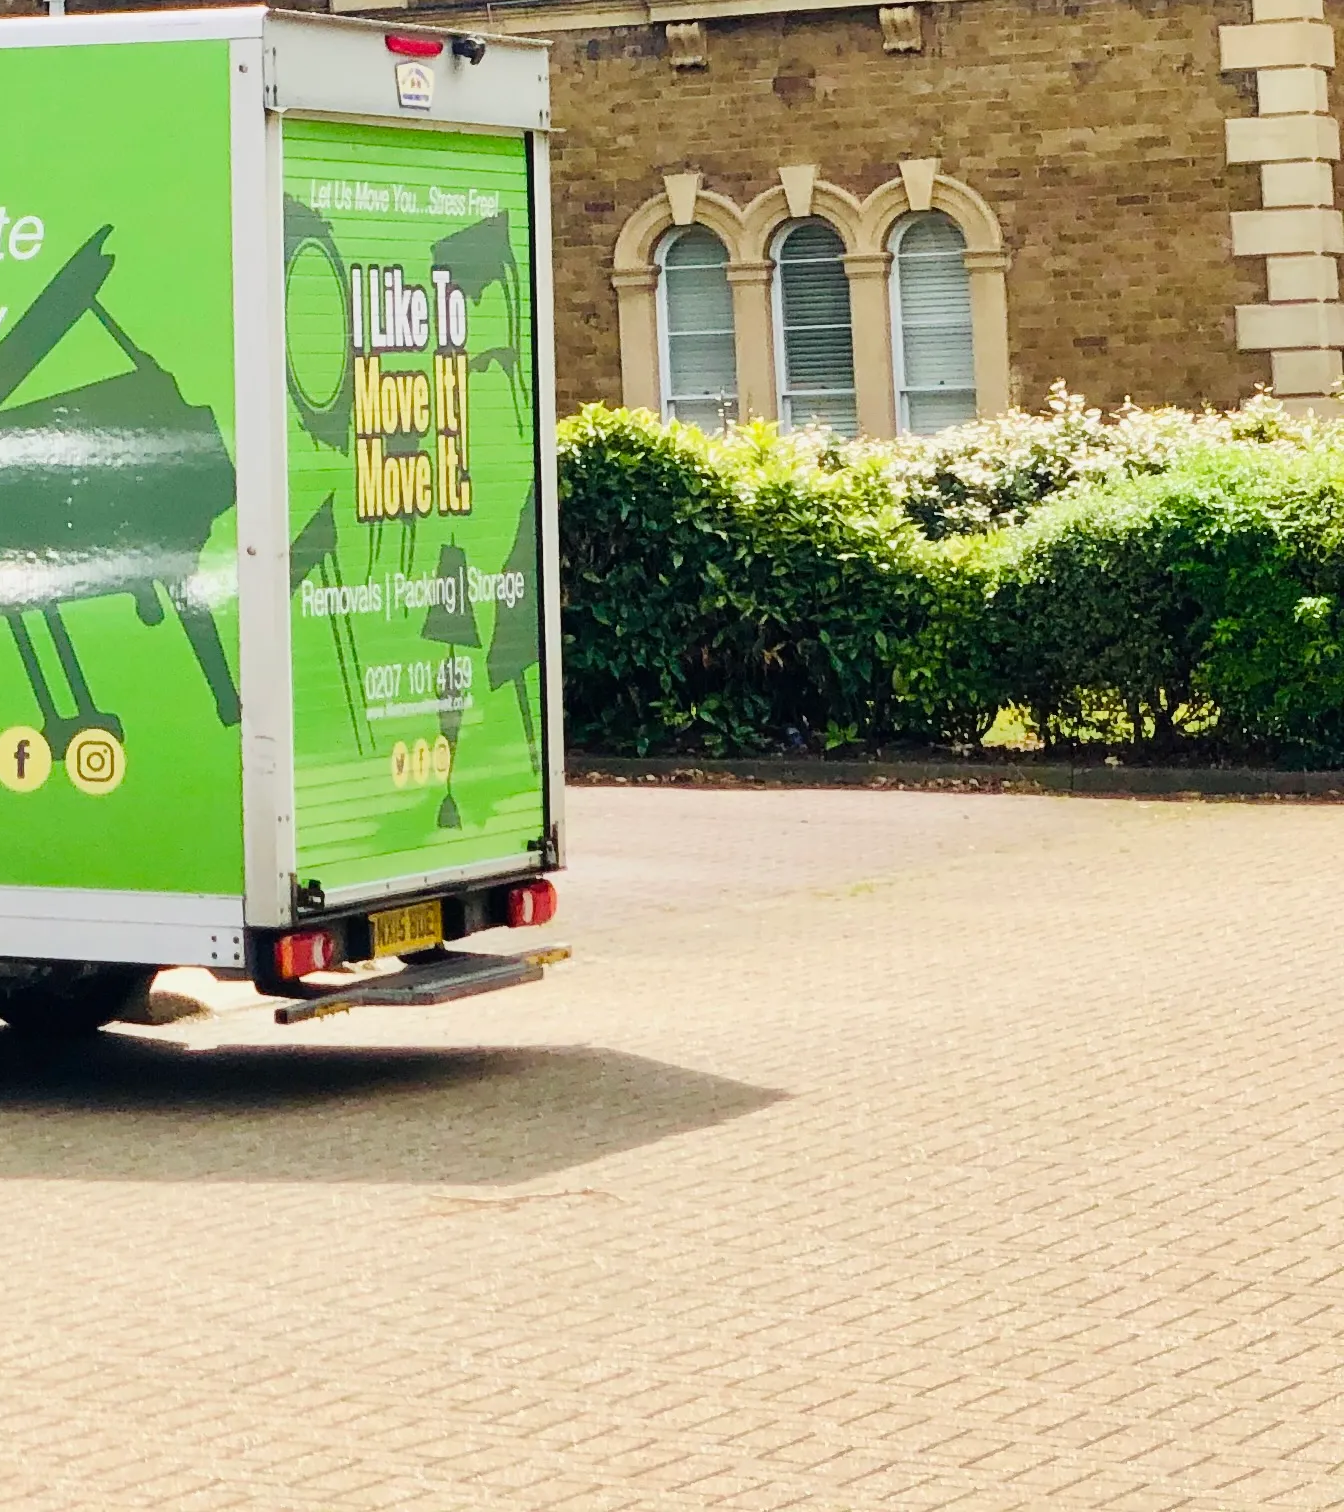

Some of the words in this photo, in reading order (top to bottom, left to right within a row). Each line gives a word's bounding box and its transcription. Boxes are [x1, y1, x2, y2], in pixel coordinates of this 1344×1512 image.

[311, 179, 331, 209] Let
[335, 181, 351, 210] Us
[355, 181, 389, 212] Move
[351, 264, 364, 351] I
[368, 264, 429, 352] Like
[431, 265, 468, 350] To
[353, 353, 430, 436] Move
[355, 435, 432, 521] Move
[301, 576, 381, 617] Removals
[394, 570, 456, 614] Packing
[467, 566, 524, 608] Storage
[365, 663, 402, 700] 0207
[408, 660, 431, 694] 101
[436, 656, 472, 691] 4159
